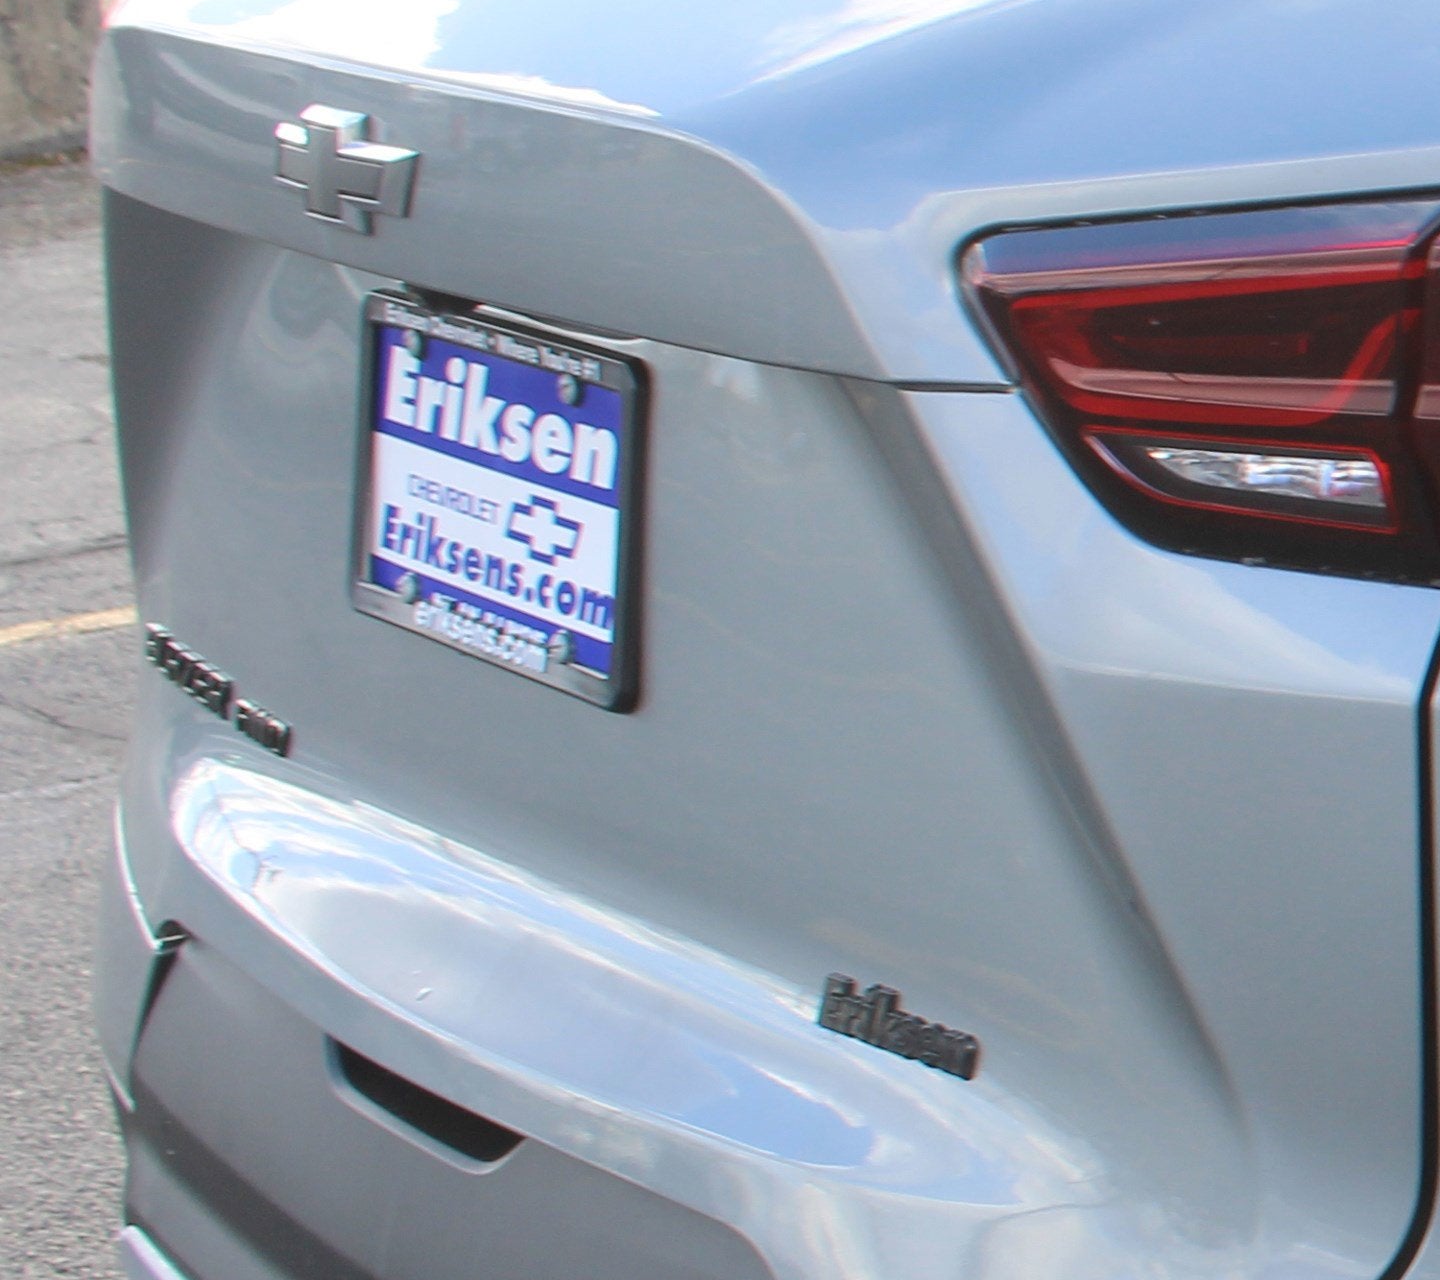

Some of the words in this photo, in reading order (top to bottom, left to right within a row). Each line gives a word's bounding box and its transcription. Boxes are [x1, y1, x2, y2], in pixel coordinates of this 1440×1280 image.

[384, 345, 619, 490] Eriksen
[407, 473, 501, 524] CHEVROLET
[381, 502, 614, 632] Eriksens.com
[818, 971, 983, 1081] Eriksen
